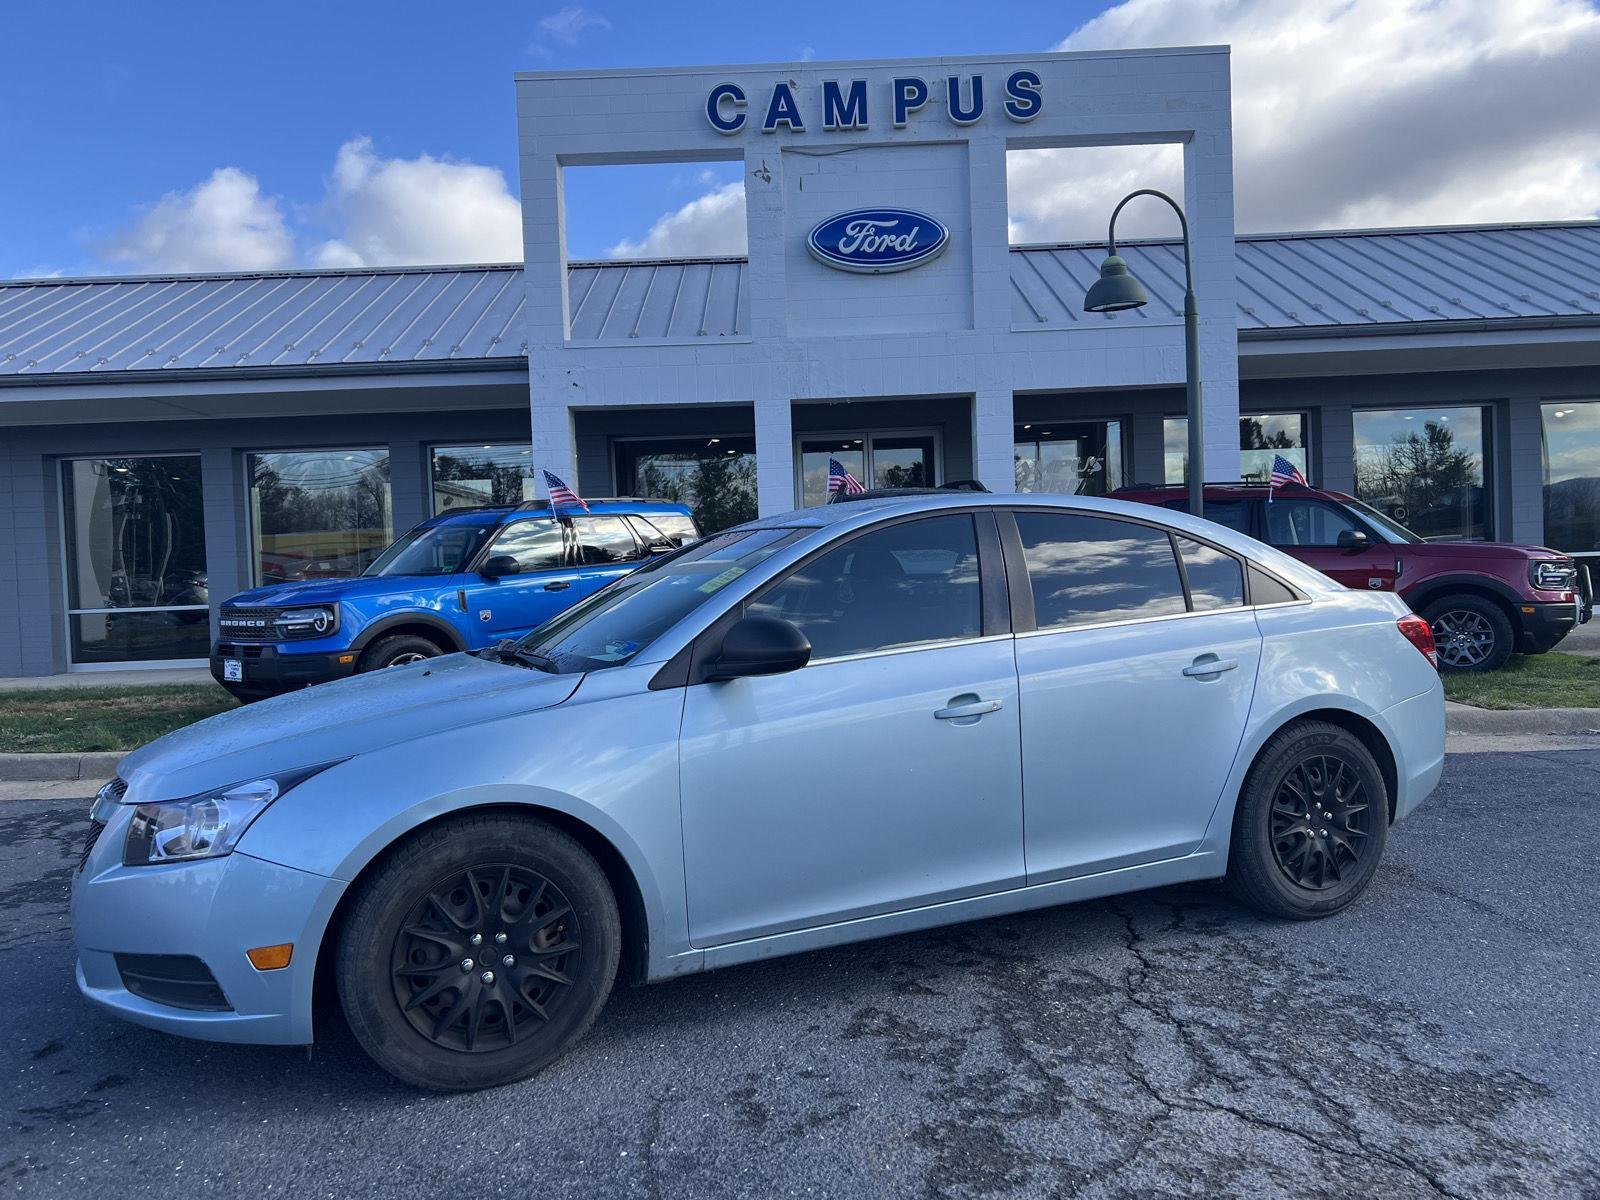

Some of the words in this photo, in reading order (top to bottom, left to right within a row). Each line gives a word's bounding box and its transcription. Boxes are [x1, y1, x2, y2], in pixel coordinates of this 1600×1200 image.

[704, 69, 1043, 136] CAMPUS
[839, 219, 919, 254] Ford
[1015, 456, 1104, 479] AMPUS
